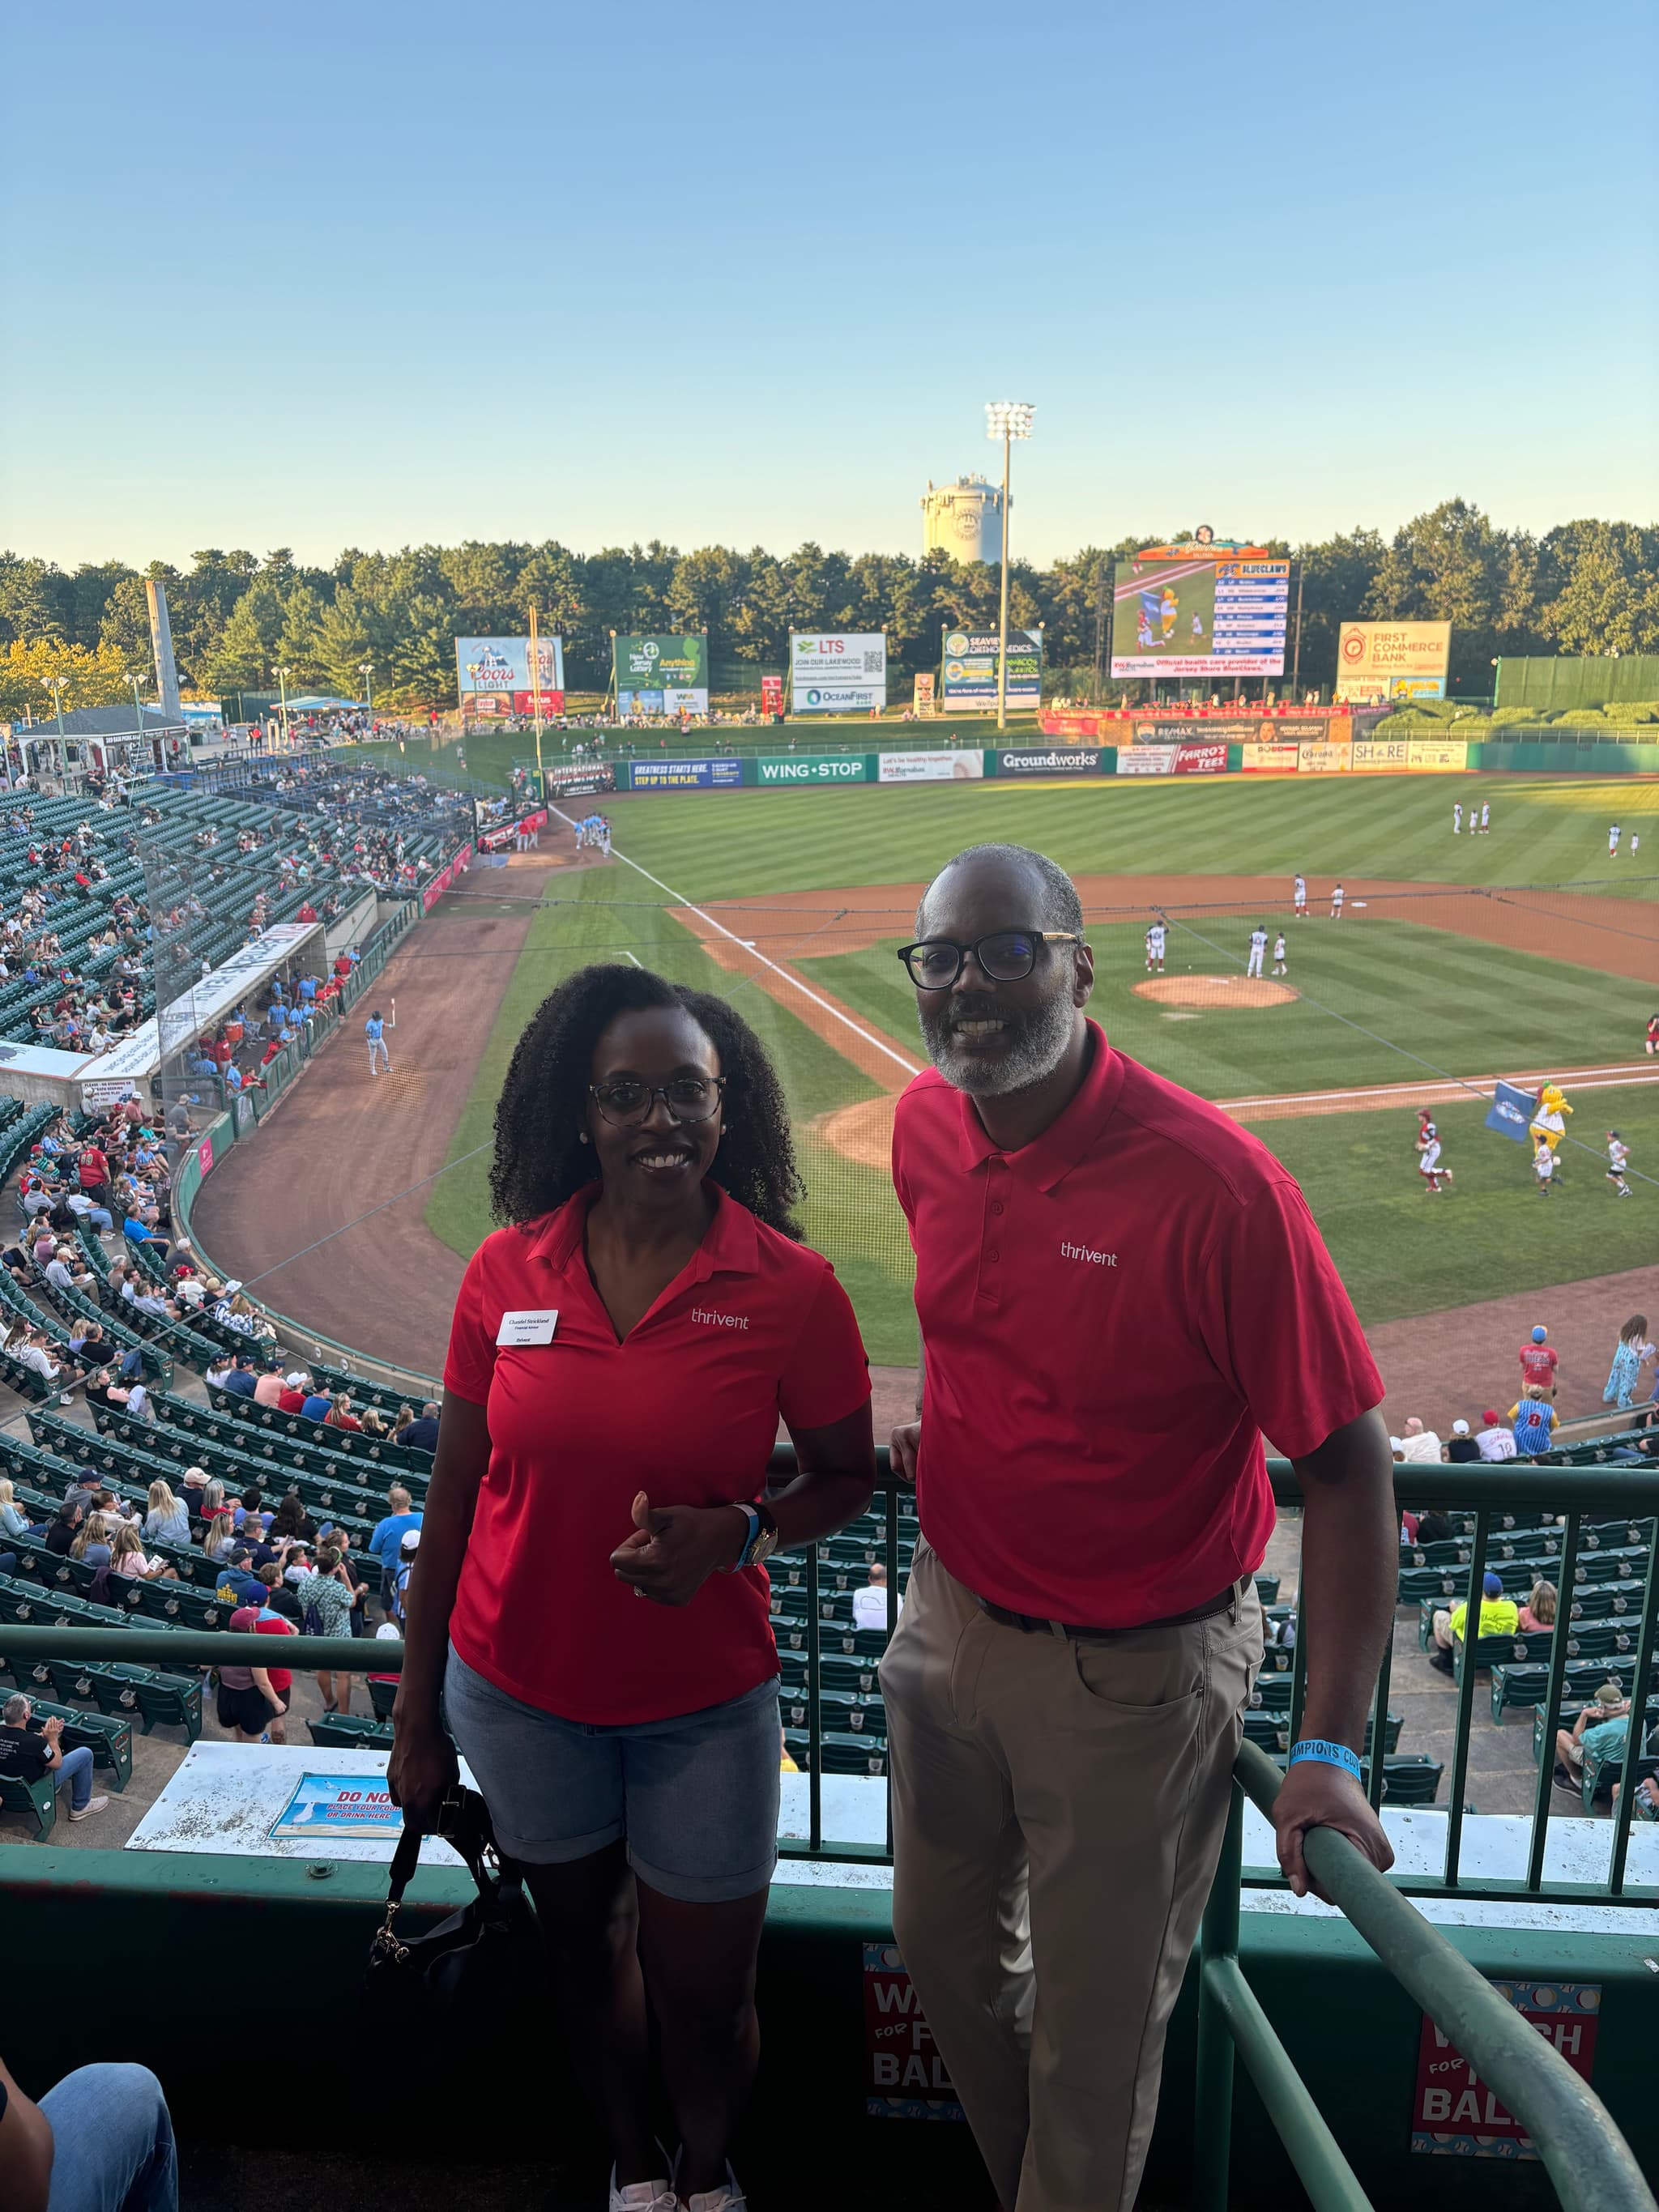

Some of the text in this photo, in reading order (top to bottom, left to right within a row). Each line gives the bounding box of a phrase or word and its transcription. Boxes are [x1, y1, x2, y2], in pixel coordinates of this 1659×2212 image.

[1373, 632, 1408, 642] FIRST
[819, 639, 845, 654] LTS
[1373, 641, 1444, 652] COMMERCE
[825, 657, 861, 665] LAKEWOOD
[1372, 653, 1407, 663] BANK
[471, 664, 516, 681] Coors
[478, 680, 510, 689] LIGHT
[1158, 726, 1192, 736] RE/MAX
[1003, 752, 1097, 769] Groundworks
[1179, 744, 1226, 762] FARRO'S
[554, 764, 604, 776] INTERNATIONAL
[634, 765, 668, 775] GREATNESS
[668, 764, 691, 774] STARTS
[691, 763, 709, 774] HERE.
[762, 762, 863, 778] WING STOP
[1197, 757, 1225, 769] TEES
[634, 774, 700, 786] STEP UP TO THE PLATE.
[1060, 1241, 1118, 1268] thrivent
[691, 1307, 750, 1330] thrivent
[1528, 1413, 1542, 1428] 8
[1291, 1742, 1340, 1759] AMPIONS
[336, 1791, 390, 1804] DO NO
[326, 1803, 354, 1811] PLACE
[356, 1804, 377, 1812] YOUR
[874, 2022, 908, 2039] FOR
[873, 2052, 956, 2090] BAL
[1428, 2057, 1465, 2074] FOR
[1421, 2086, 1522, 2126] BAL
